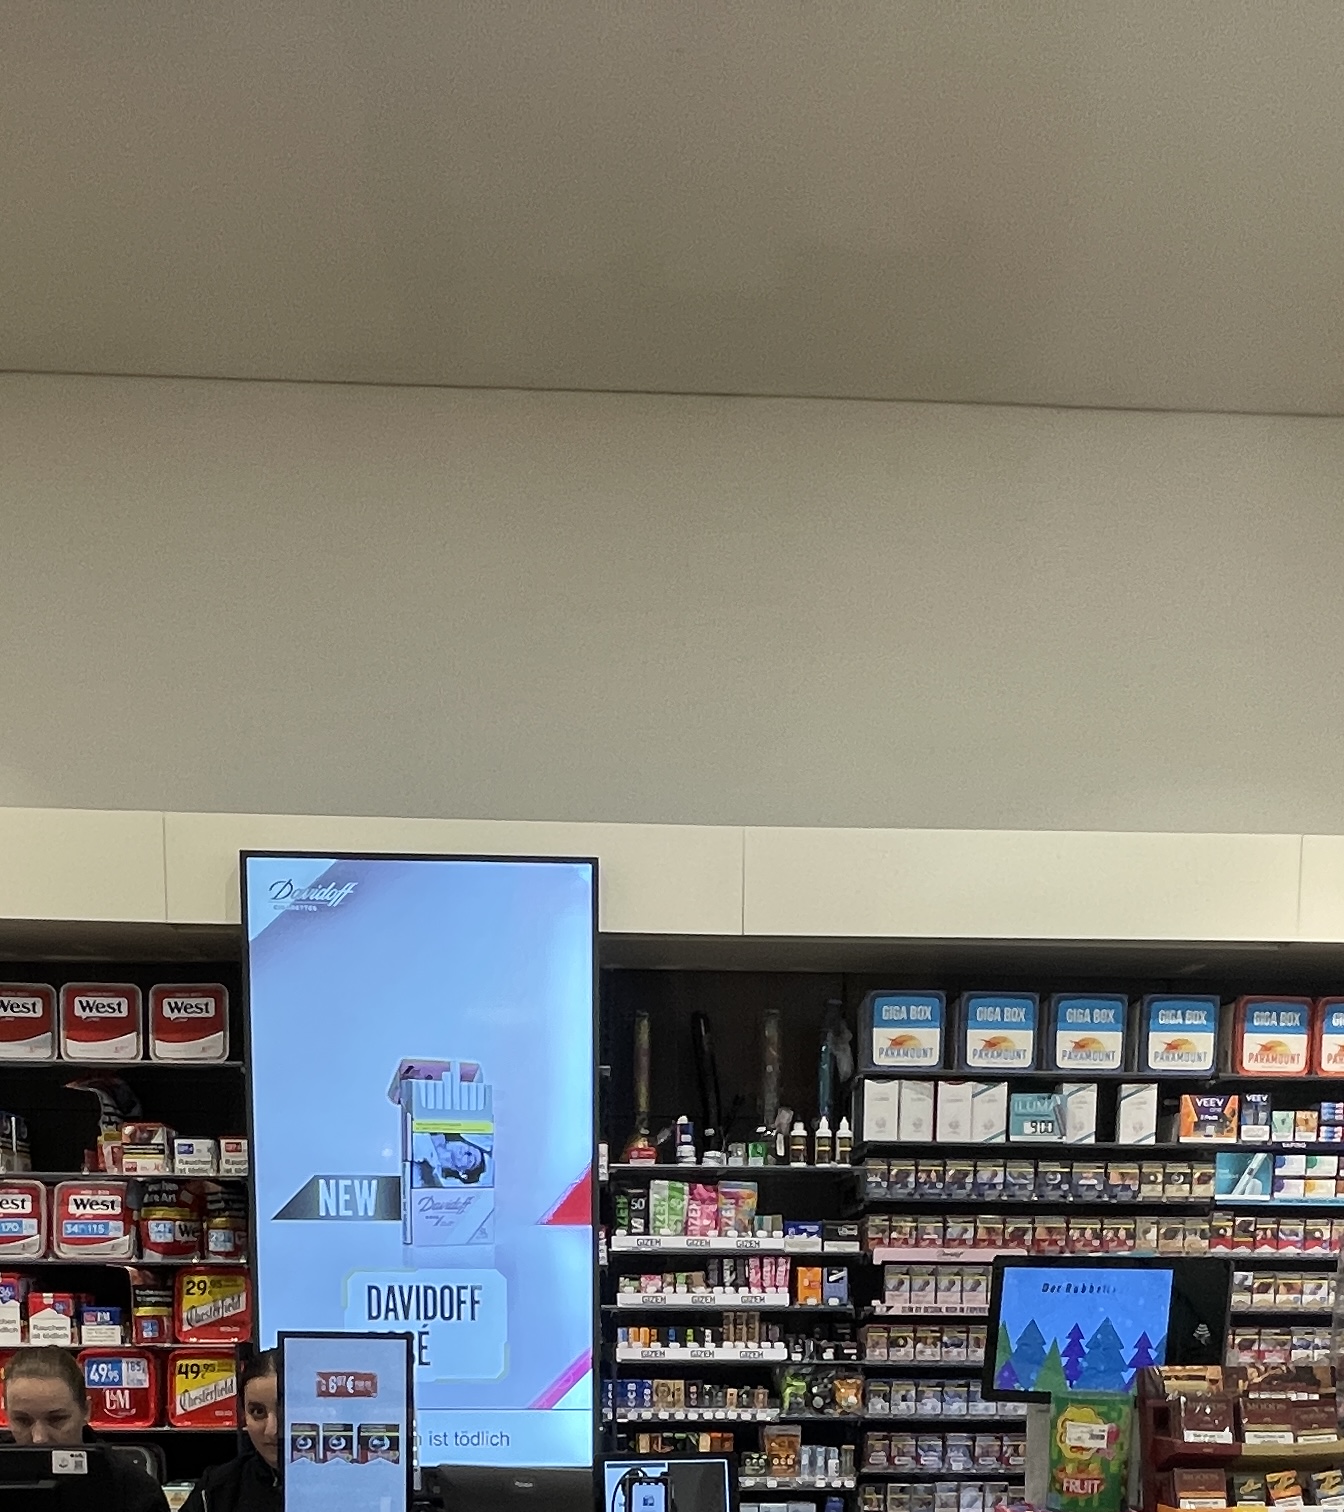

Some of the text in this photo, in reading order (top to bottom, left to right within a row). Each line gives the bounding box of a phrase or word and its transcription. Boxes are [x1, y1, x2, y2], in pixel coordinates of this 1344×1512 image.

[269, 879, 358, 907] Davidoff
[79, 1000, 123, 1013] West
[168, 1001, 210, 1014] West
[882, 1006, 932, 1020] GIGA BOX
[977, 1008, 1025, 1022] GIGA BOX
[1066, 1008, 1115, 1024] GIGA BOX
[1159, 1010, 1207, 1025] GIGA BOX
[1253, 1012, 1301, 1027] GIGA BOX
[879, 1047, 933, 1060] PARAMOUNT
[972, 1048, 1027, 1061] PARAMOUNT
[1062, 1050, 1116, 1062] PARAMOUNT
[1154, 1051, 1207, 1064] PARAMOUNT
[1248, 1053, 1301, 1065] PARAMOUNT
[1196, 1098, 1224, 1106] VEEV
[73, 1197, 116, 1211] West
[319, 1179, 377, 1216] NEW
[637, 1239, 661, 1247] GIZEH
[686, 1239, 710, 1247] GIZEH
[736, 1240, 760, 1248] GIZEH
[1042, 1283, 1062, 1293] Der
[367, 1285, 482, 1321] DAVIDOFF
[642, 1296, 666, 1304] GIZEH
[692, 1296, 715, 1304] GIZEH
[741, 1296, 765, 1304] GIZEH
[187, 1296, 241, 1327] Chesterfield
[641, 1350, 665, 1358] GIZEH
[691, 1350, 714, 1358] GIZEH
[180, 1379, 234, 1411] Chesterfield
[429, 1431, 510, 1447] ist tödlich
[1063, 1478, 1101, 1494] FRUIT
